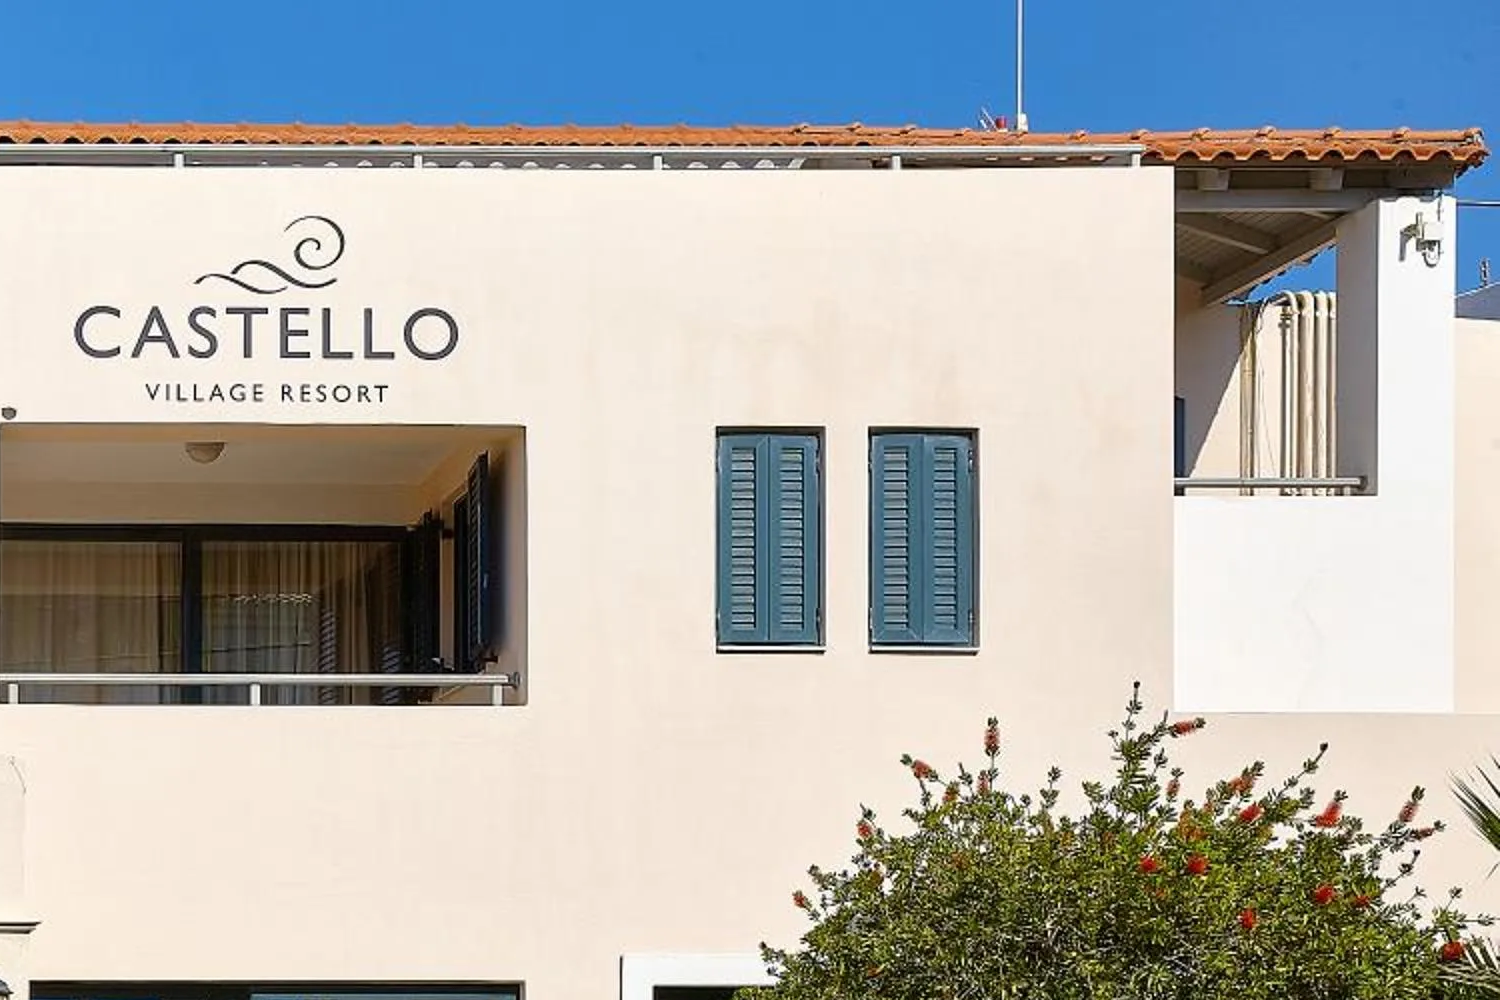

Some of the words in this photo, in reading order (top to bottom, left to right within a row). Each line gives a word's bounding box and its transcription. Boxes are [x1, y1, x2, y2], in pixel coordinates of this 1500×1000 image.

[74, 305, 459, 361] CASTELLO
[145, 383, 264, 403] VILLAGE
[280, 383, 389, 403] RESORT
